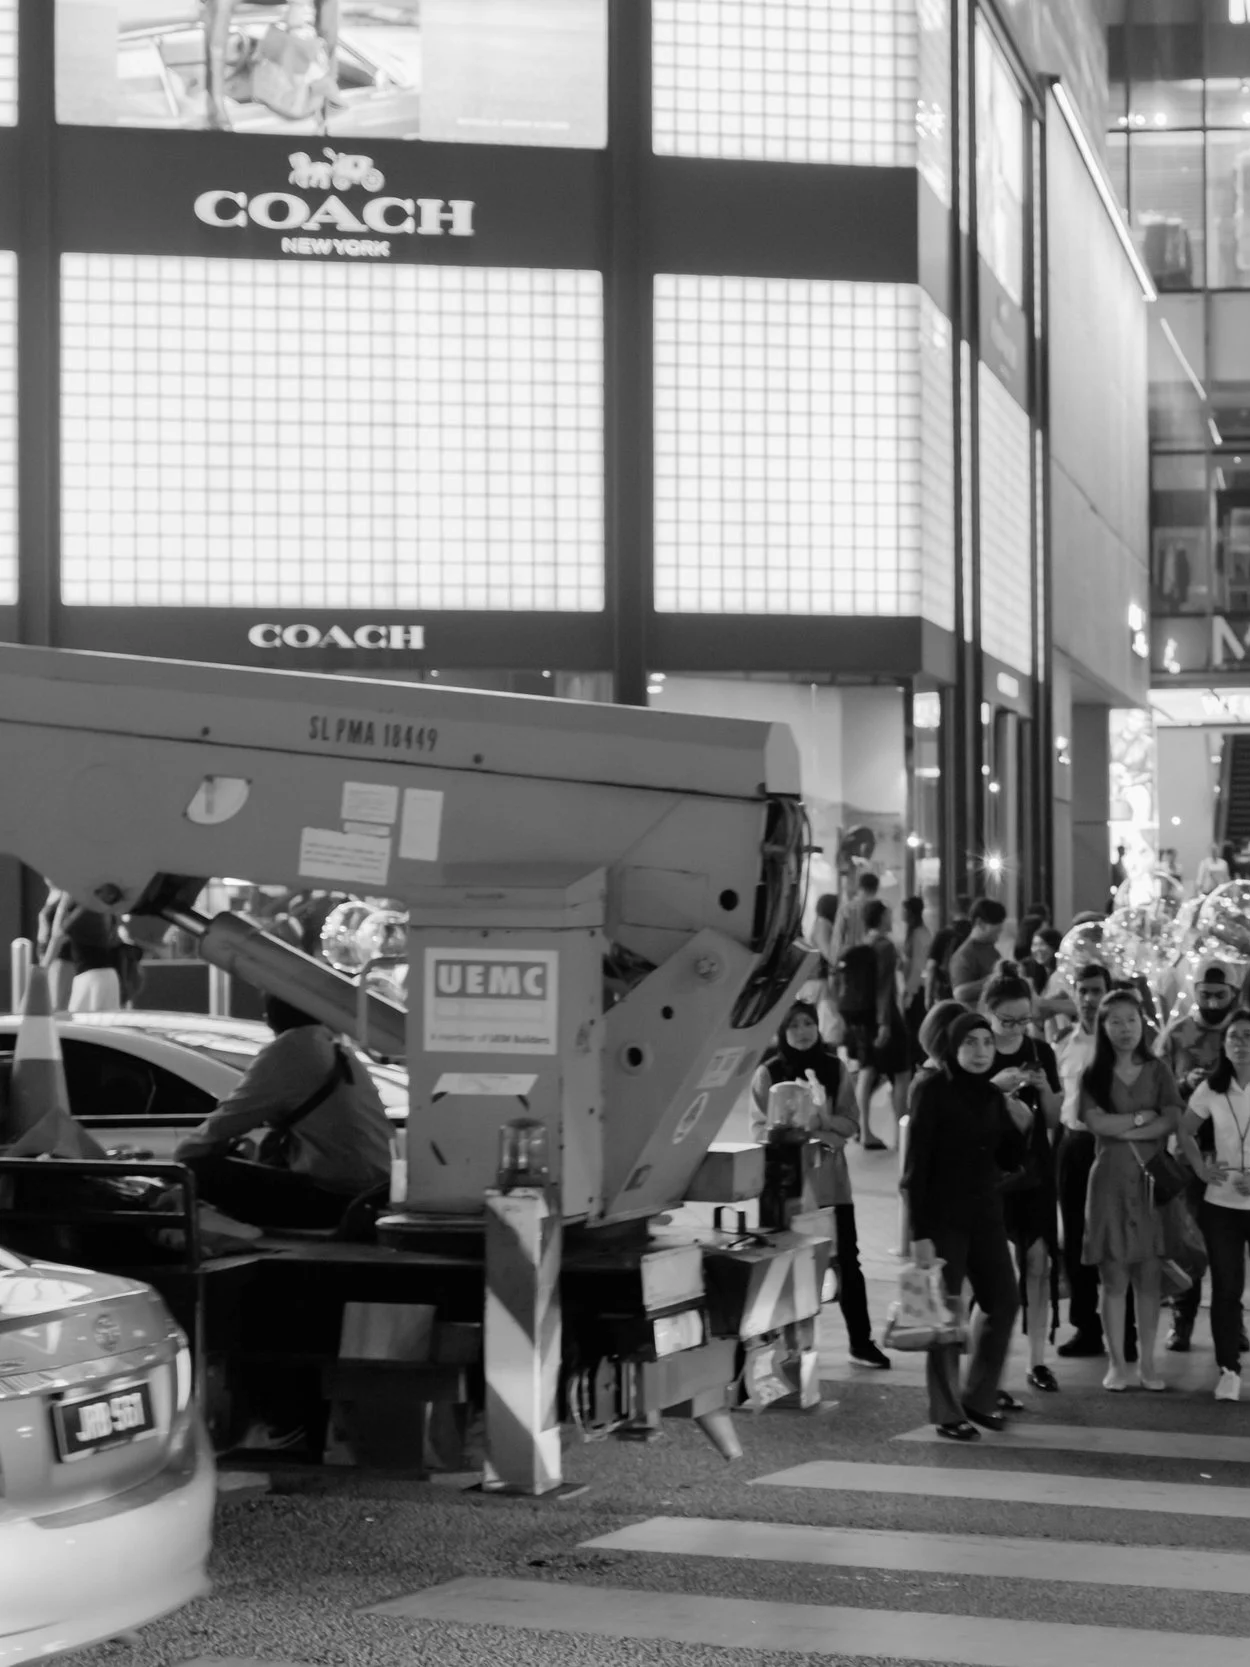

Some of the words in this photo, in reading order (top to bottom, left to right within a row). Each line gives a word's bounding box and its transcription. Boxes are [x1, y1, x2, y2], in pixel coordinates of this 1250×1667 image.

[194, 190, 476, 236] COACH
[281, 237, 333, 255] NEW
[333, 238, 391, 257] YORK
[248, 623, 425, 650] COACH
[382, 723, 438, 751] 18449
[437, 964, 544, 997] UEMC
